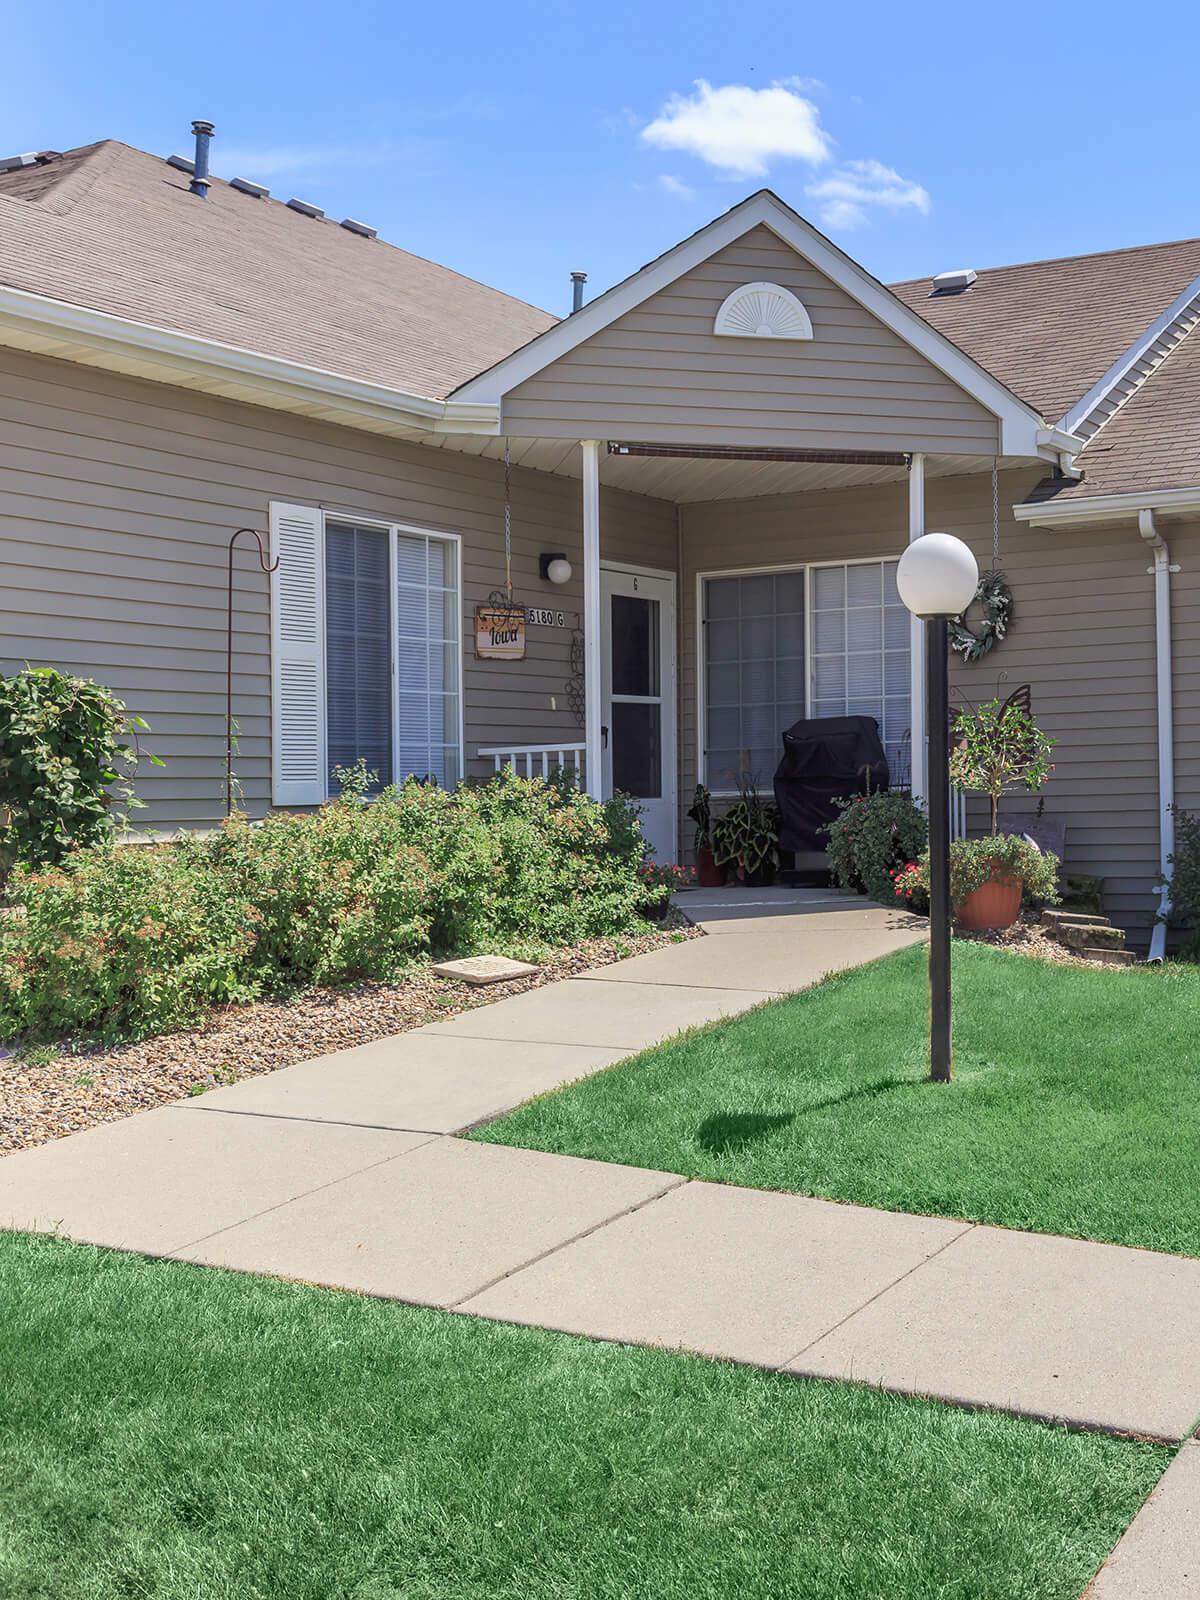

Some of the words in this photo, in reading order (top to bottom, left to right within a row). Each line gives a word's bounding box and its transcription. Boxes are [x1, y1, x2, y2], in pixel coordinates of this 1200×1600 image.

[529, 609, 553, 625] 5180
[558, 613, 564, 626] G
[489, 625, 518, 646] Iowa
